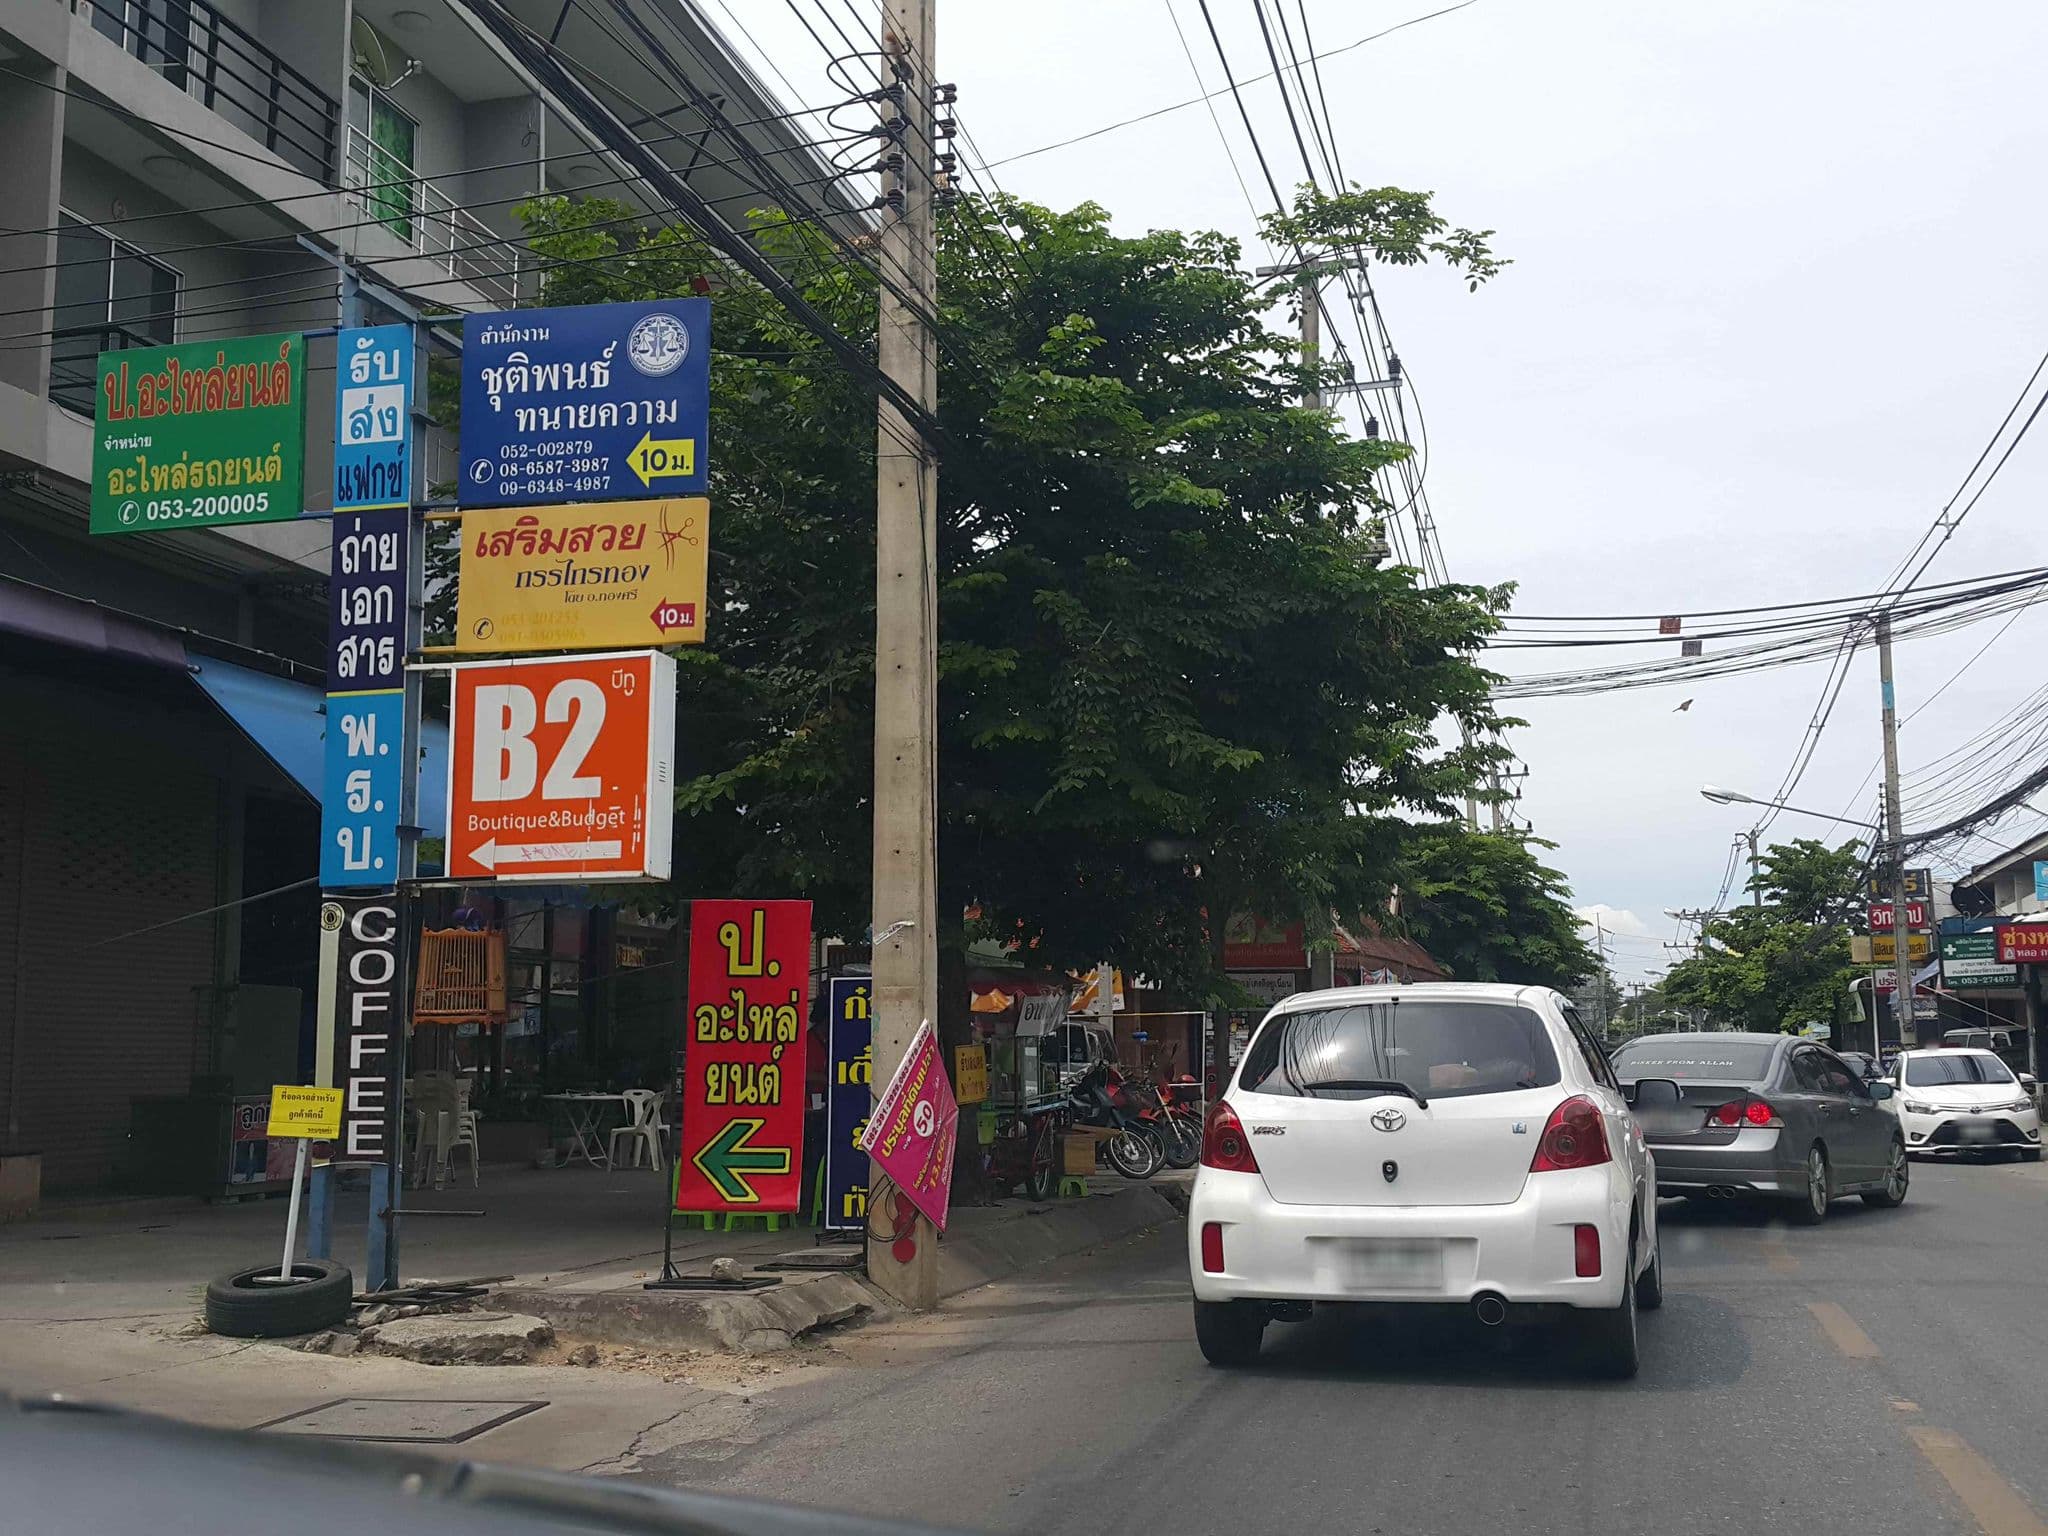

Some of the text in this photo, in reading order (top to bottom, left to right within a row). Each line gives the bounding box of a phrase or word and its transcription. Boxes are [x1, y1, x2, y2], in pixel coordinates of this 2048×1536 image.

[480, 324, 550, 345] สำนักงาน
[103, 340, 292, 422] ป.อะไหล่ยนต์
[349, 337, 400, 383] รับ
[481, 340, 618, 412] ชุติพนธ์
[349, 393, 399, 439] ส่ง
[514, 399, 678, 433] ทนายความ
[104, 433, 152, 451] จำหน่าย
[500, 440, 593, 459] 052-002879
[640, 449, 690, 473] 10 ม.
[107, 442, 281, 496] อะไหล่รถยนต์
[337, 442, 405, 502] แฟกซ์
[499, 457, 610, 478] 08-6587-3987
[499, 476, 611, 496] 09-6348-4987
[146, 492, 269, 521] 053-200005
[339, 517, 398, 574] ถ่าย
[474, 515, 647, 558] เสริมสวย
[340, 584, 393, 626] เอก
[659, 608, 678, 625] 10
[337, 634, 395, 678] สาร
[611, 668, 635, 697] บีทู
[340, 713, 389, 757] พ.
[471, 678, 607, 802] B2
[346, 769, 384, 813] ร.
[468, 809, 626, 832] Boutique&Budget
[336, 826, 384, 871] บ.
[719, 909, 780, 977] ป.
[347, 906, 397, 1155] COFFEE
[695, 990, 799, 1042] อะไหล่
[706, 1045, 783, 1106] ยนต์
[916, 1103, 933, 1135] 50
